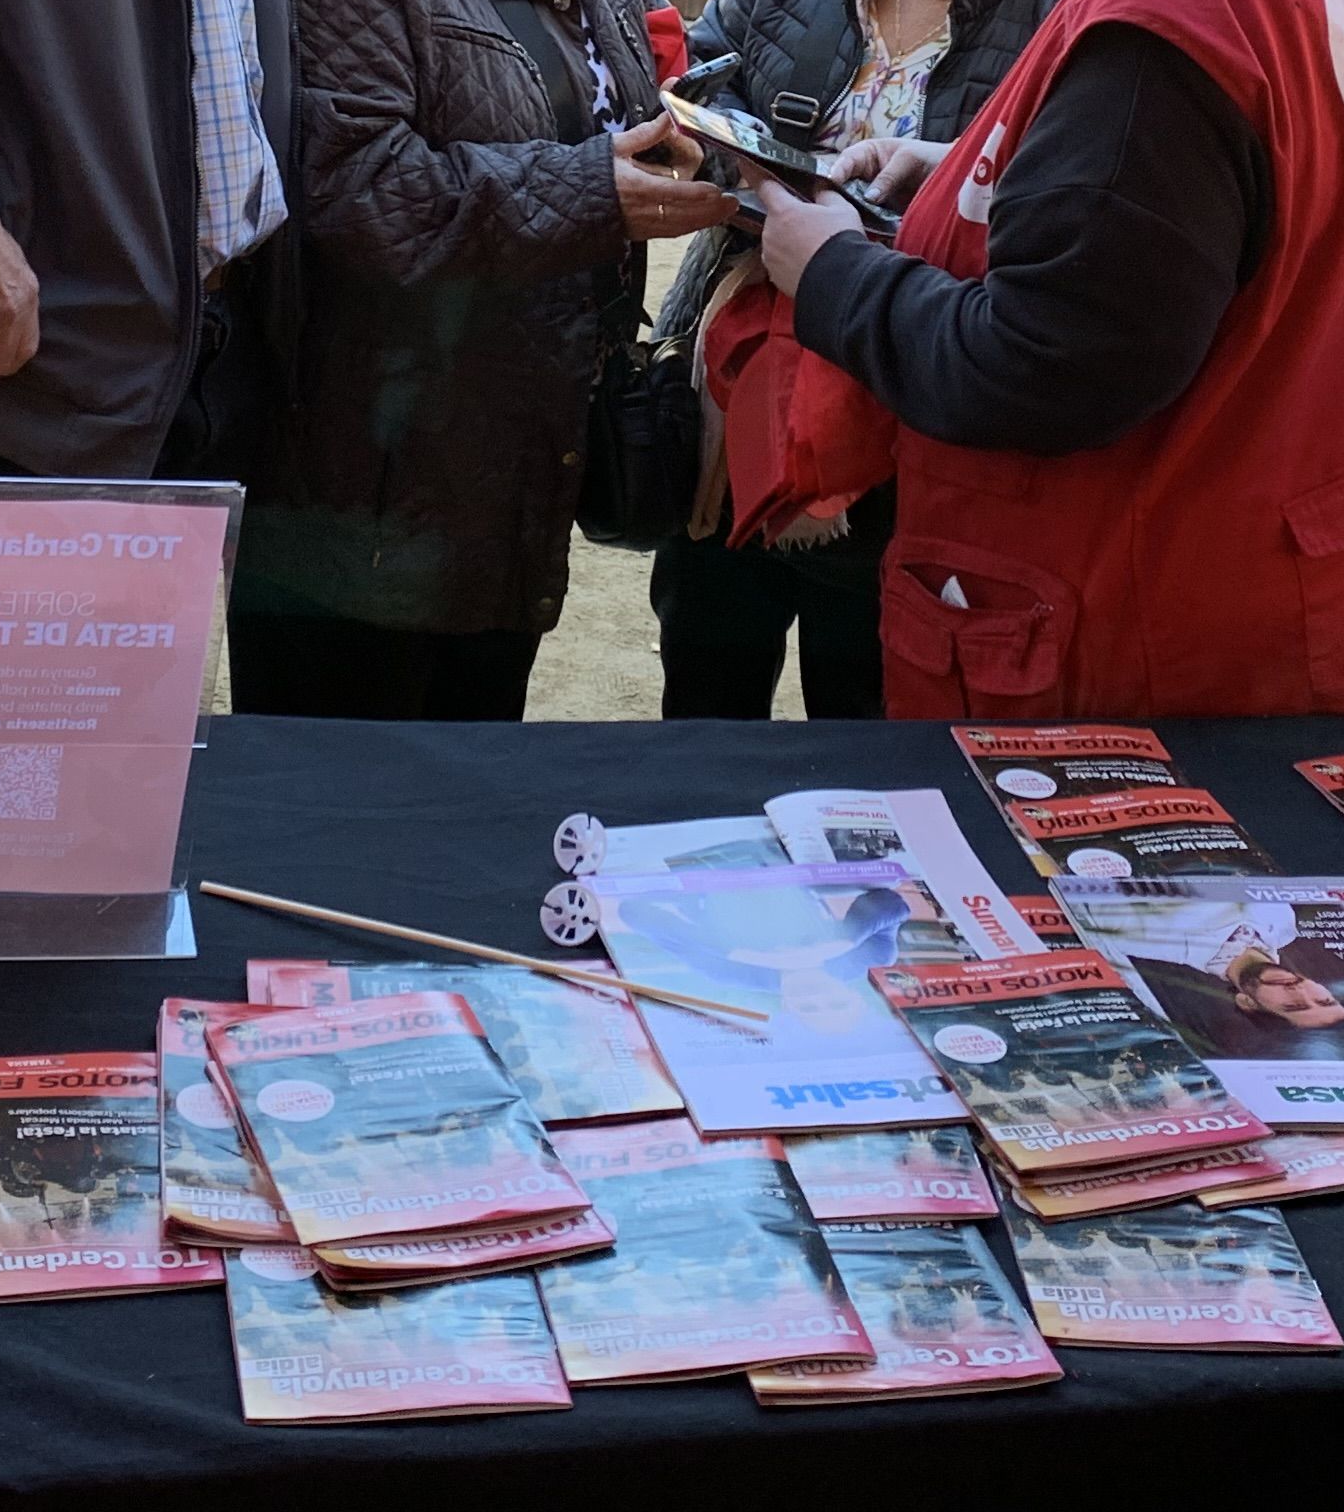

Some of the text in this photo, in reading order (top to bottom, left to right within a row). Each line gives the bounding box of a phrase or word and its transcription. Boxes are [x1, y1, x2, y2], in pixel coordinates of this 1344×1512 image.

[977, 740, 1153, 752] MOTOS FURIÓ
[1037, 801, 1215, 832] MOTOS FURIÓ
[962, 894, 1020, 955] Sumar
[903, 965, 1104, 1005] MOTOS FURIÓ
[1013, 1016, 1062, 1033] Festa!
[34, 1073, 157, 1088] MOTOS
[764, 1074, 952, 1110] otsalut
[17, 1127, 76, 1139] Festa!
[1021, 1115, 1248, 1152] TOT Cerdanyola
[908, 1178, 980, 1202] TOT
[131, 1248, 209, 1269] TOT
[1040, 1287, 1102, 1302] aldia
[1059, 1301, 1248, 1328] Cerdanyola
[966, 1343, 1040, 1367] TOT
[271, 1363, 473, 1399] Cerdanyola
